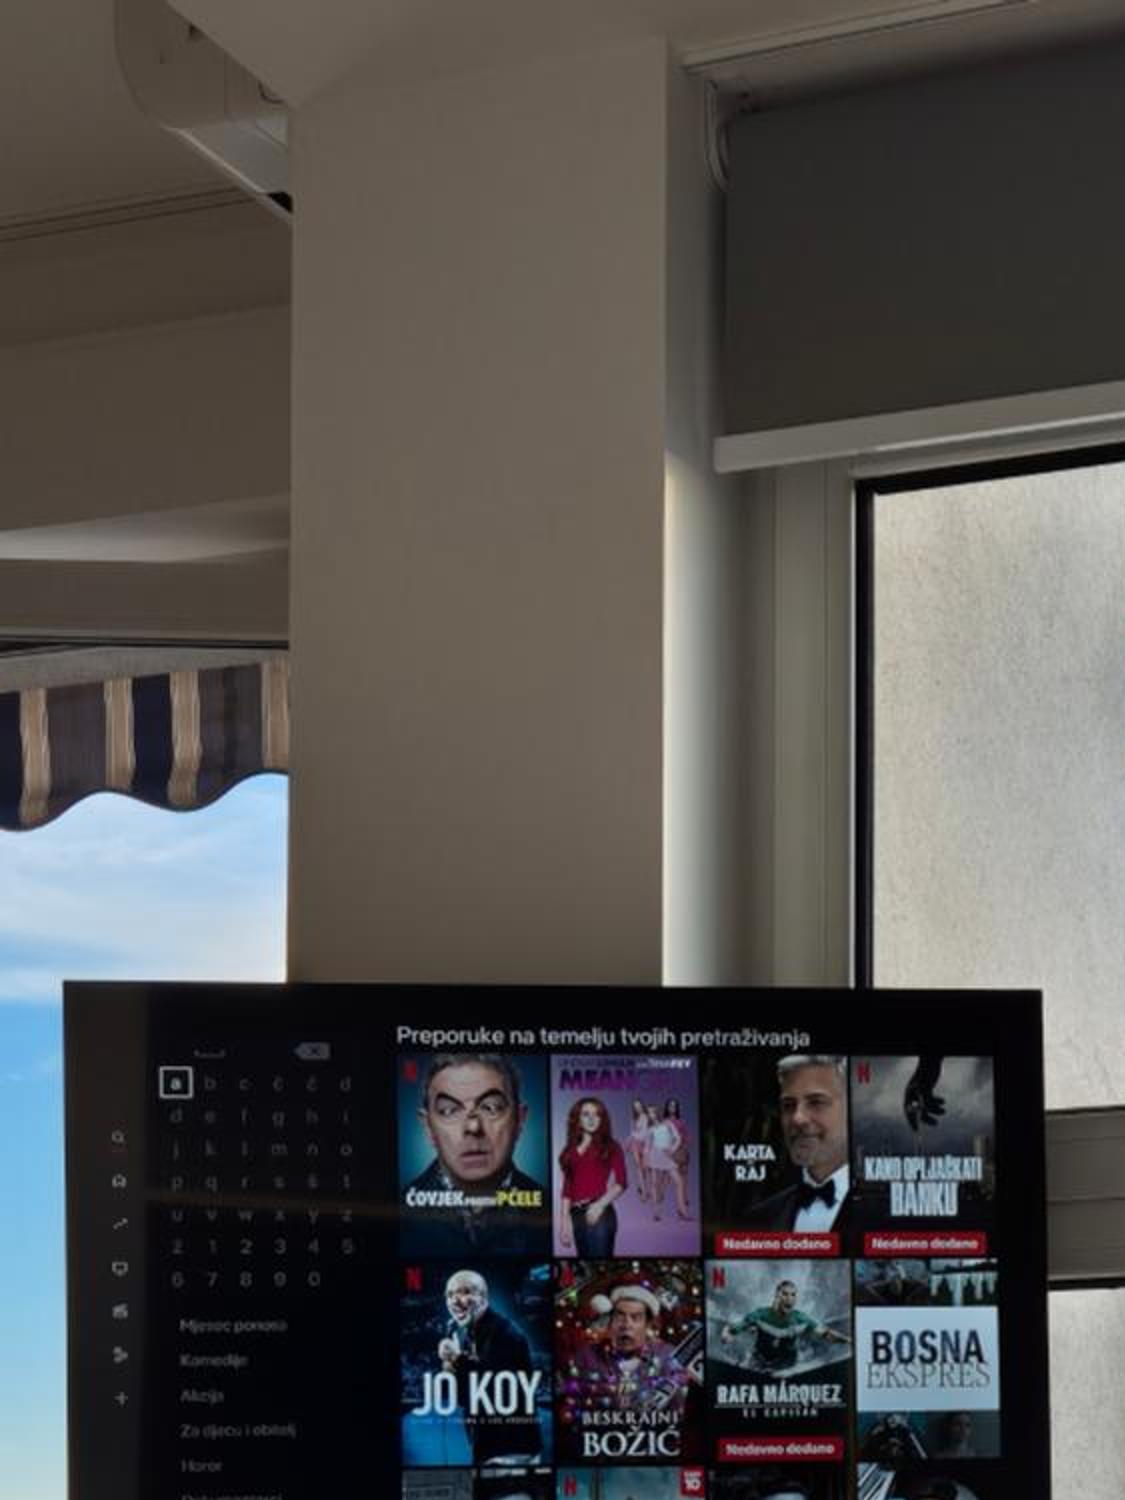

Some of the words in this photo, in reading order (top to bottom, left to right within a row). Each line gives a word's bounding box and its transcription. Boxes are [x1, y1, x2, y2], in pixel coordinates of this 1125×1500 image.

[397, 1026, 504, 1048] Preporuke
[509, 1029, 535, 1045] na
[541, 1026, 615, 1049] temelju
[620, 1027, 676, 1050] tvojih
[680, 1027, 810, 1051] pretraživanja
[723, 1144, 775, 1160] KARTA
[735, 1165, 767, 1182] RAJ
[723, 1238, 780, 1250] Nedavno
[782, 1238, 832, 1250] dodano
[872, 1238, 928, 1250] Nedavno
[930, 1238, 979, 1250] dodano
[871, 1329, 984, 1365] BOSNA
[866, 1362, 990, 1389] EKSPRES
[411, 1371, 458, 1415] JO
[469, 1371, 543, 1415] KOY
[717, 1385, 759, 1403] RAFA
[763, 1379, 842, 1406] MÁRQUEZ
[583, 1410, 679, 1426] BESKRAJNI
[583, 1425, 681, 1456] BOŽIĆ
[726, 1443, 784, 1456] Nedavno
[786, 1442, 835, 1455] dodano
